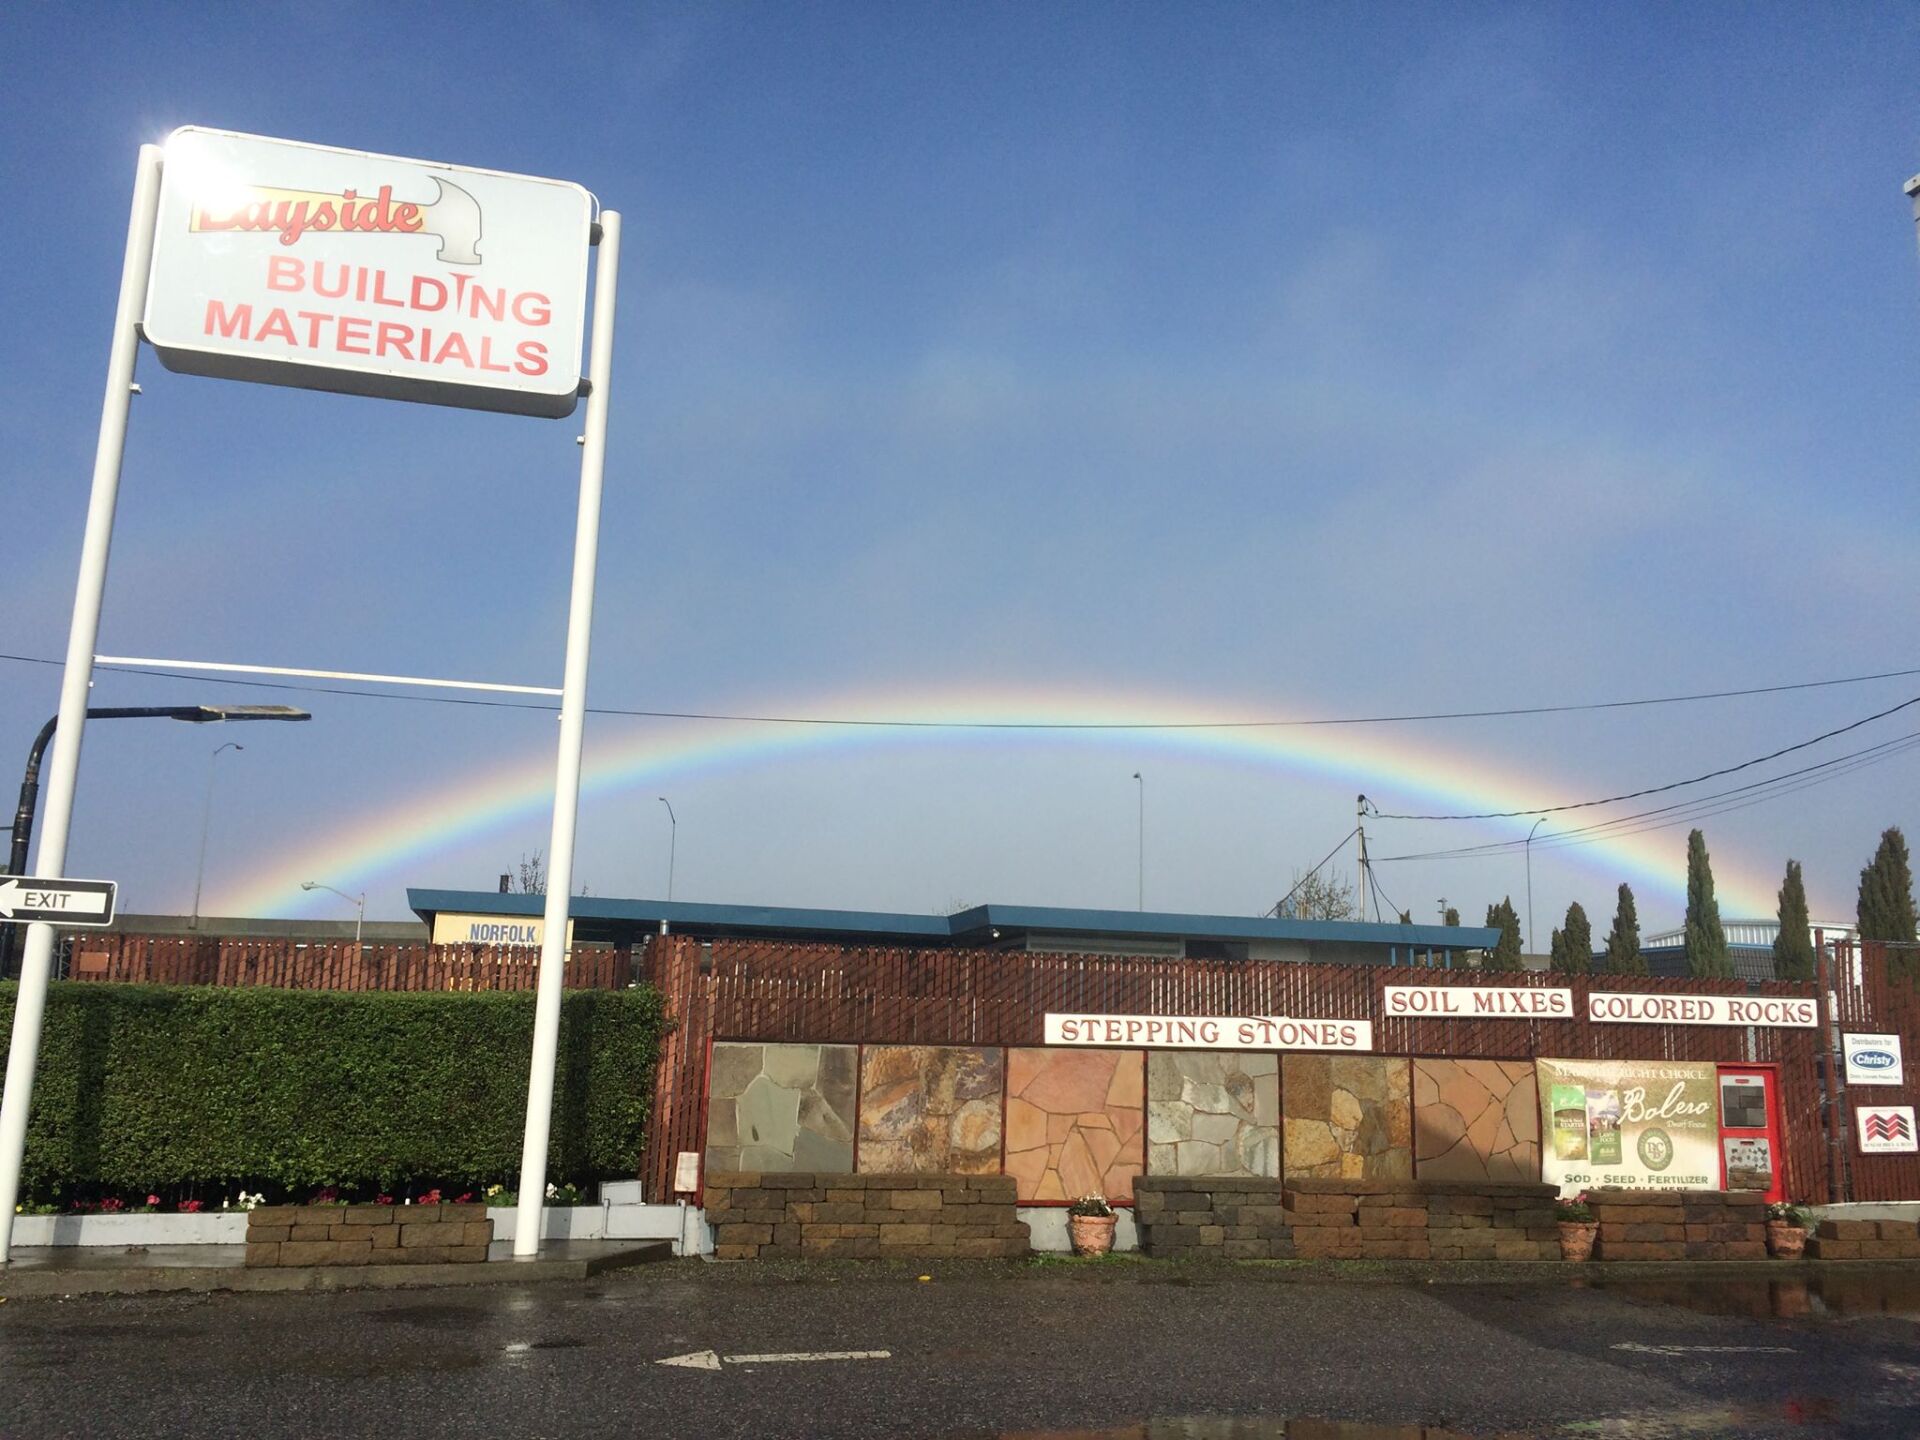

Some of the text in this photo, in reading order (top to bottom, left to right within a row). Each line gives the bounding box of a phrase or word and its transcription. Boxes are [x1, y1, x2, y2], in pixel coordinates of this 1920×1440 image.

[266, 254, 552, 326] BUILDING
[203, 299, 550, 376] MATERIALS
[24, 892, 71, 909] EXIT
[470, 923, 536, 943] NORFOLK
[1391, 990, 1567, 1014] SOIL MIXES
[1591, 997, 1814, 1024] COLORED ROCKS
[1061, 1019, 1357, 1046] STEPPING STONES
[1856, 1054, 1891, 1067] Christy
[1617, 1081, 1710, 1125] Bolero
[1564, 1174, 1708, 1184] SOD SEED FERTILIZER
